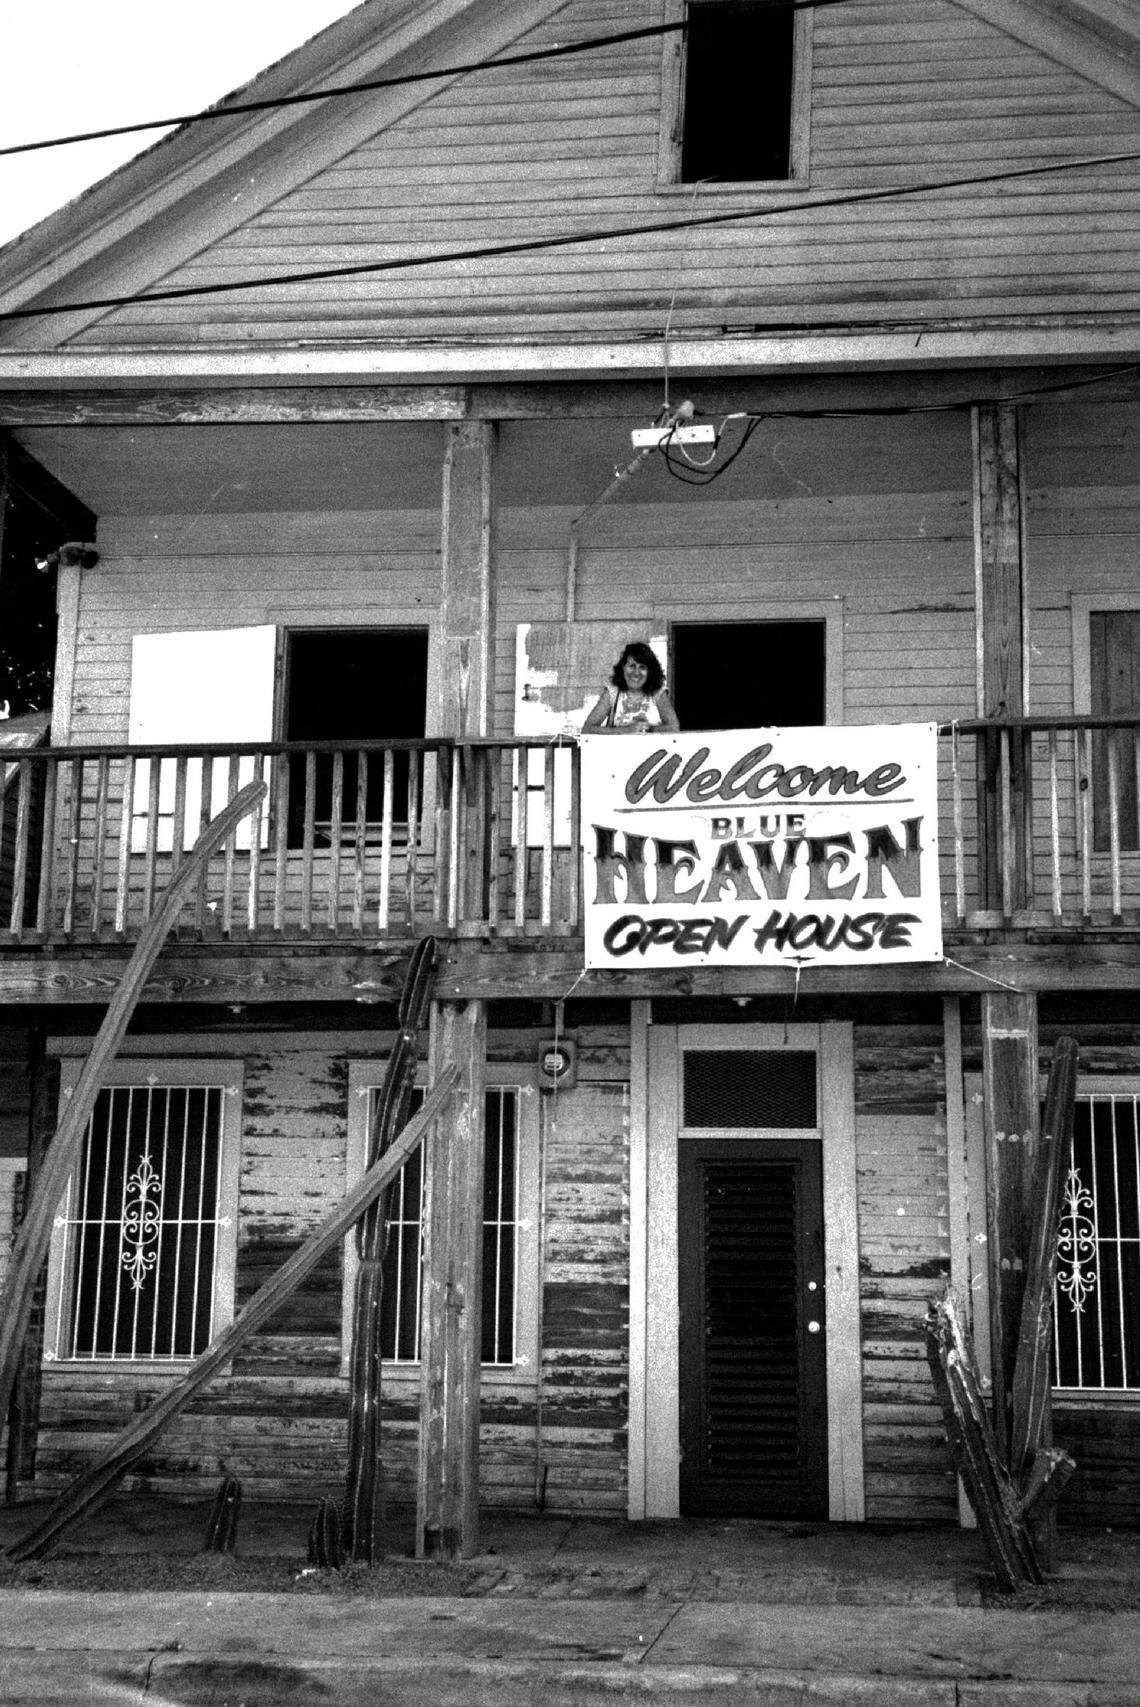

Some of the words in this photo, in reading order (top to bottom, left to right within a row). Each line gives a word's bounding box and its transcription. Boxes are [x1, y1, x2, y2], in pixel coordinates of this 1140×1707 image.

[625, 743, 906, 804] Welcome
[711, 814, 806, 839] BLUE
[591, 816, 924, 905] HEAVEN
[603, 914, 750, 957] OPEN
[753, 910, 922, 953] HOUSE
